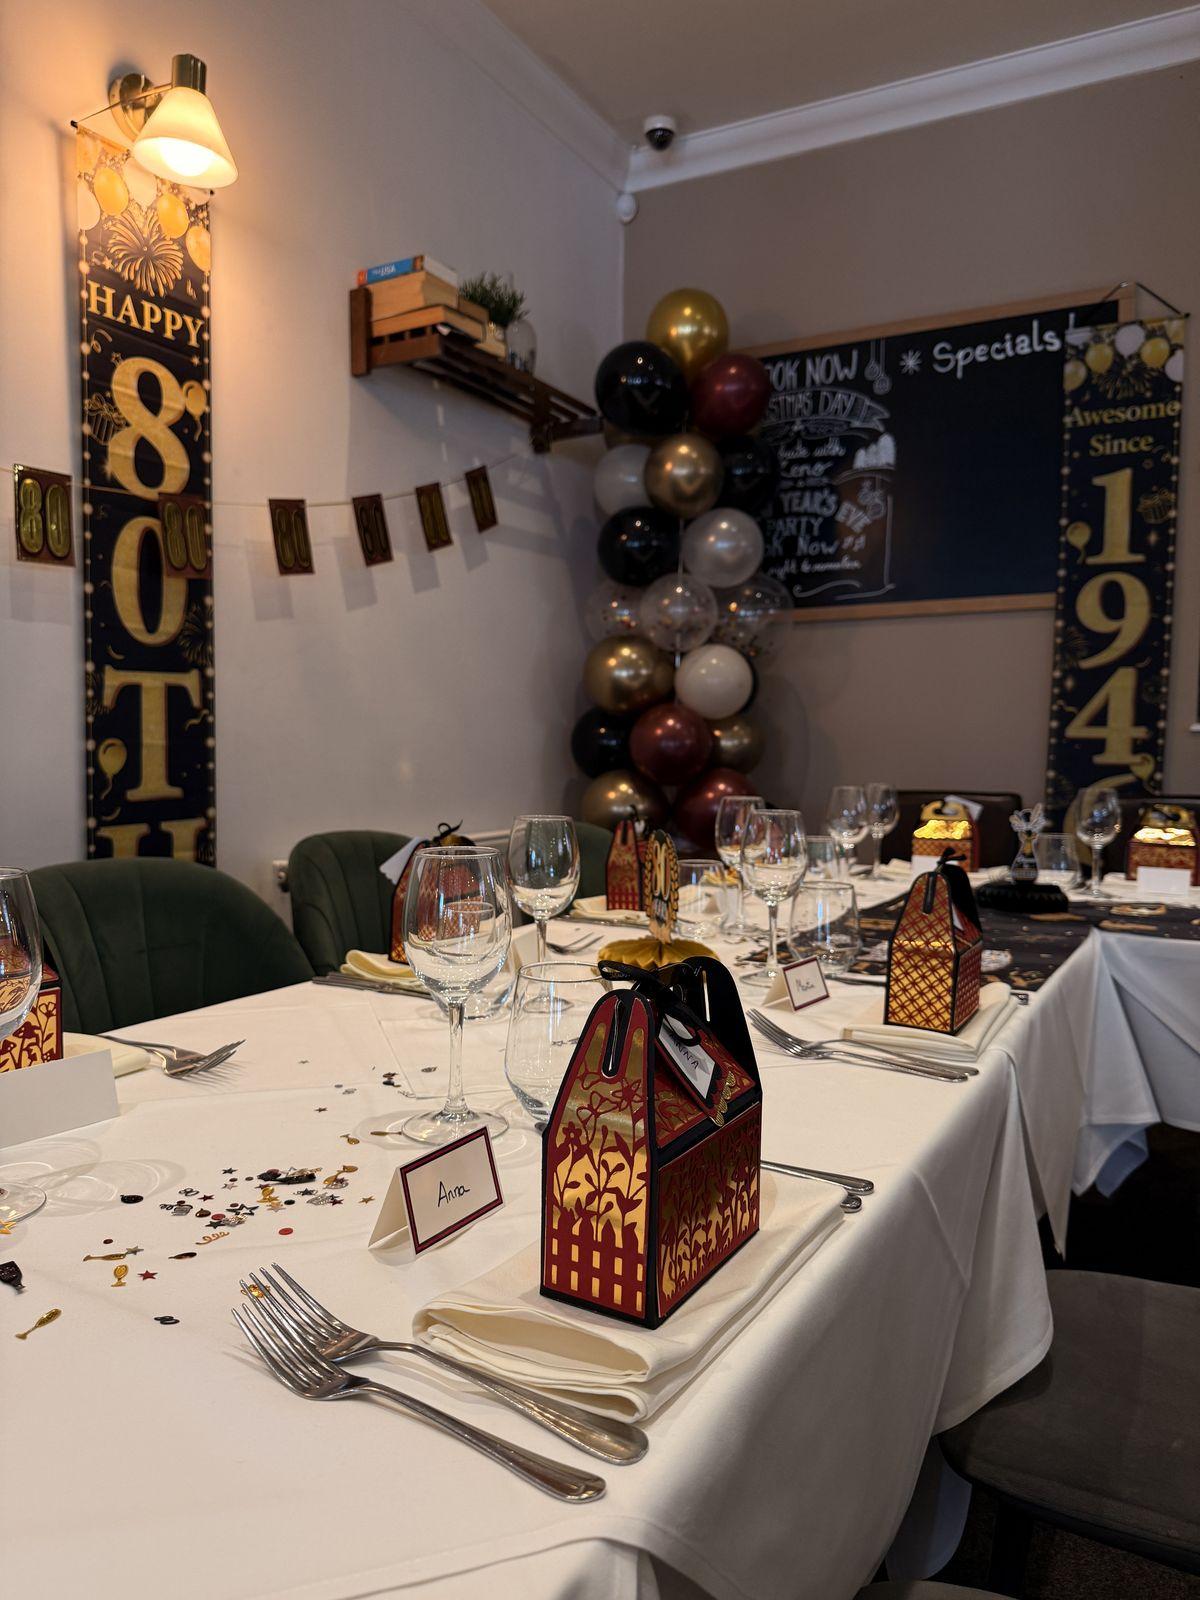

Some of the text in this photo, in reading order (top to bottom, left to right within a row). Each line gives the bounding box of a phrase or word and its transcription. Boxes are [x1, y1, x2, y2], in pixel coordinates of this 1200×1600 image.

[87, 279, 204, 348] HAPPY
[764, 348, 859, 391] OK NOW
[768, 391, 858, 420] STMAS DAY
[1067, 400, 1181, 429] Awesome
[1089, 434, 1154, 457] Since
[19, 477, 72, 558] 80
[766, 515, 824, 538] PARTY
[164, 501, 207, 570] 80
[437, 1180, 471, 1208] Anna
